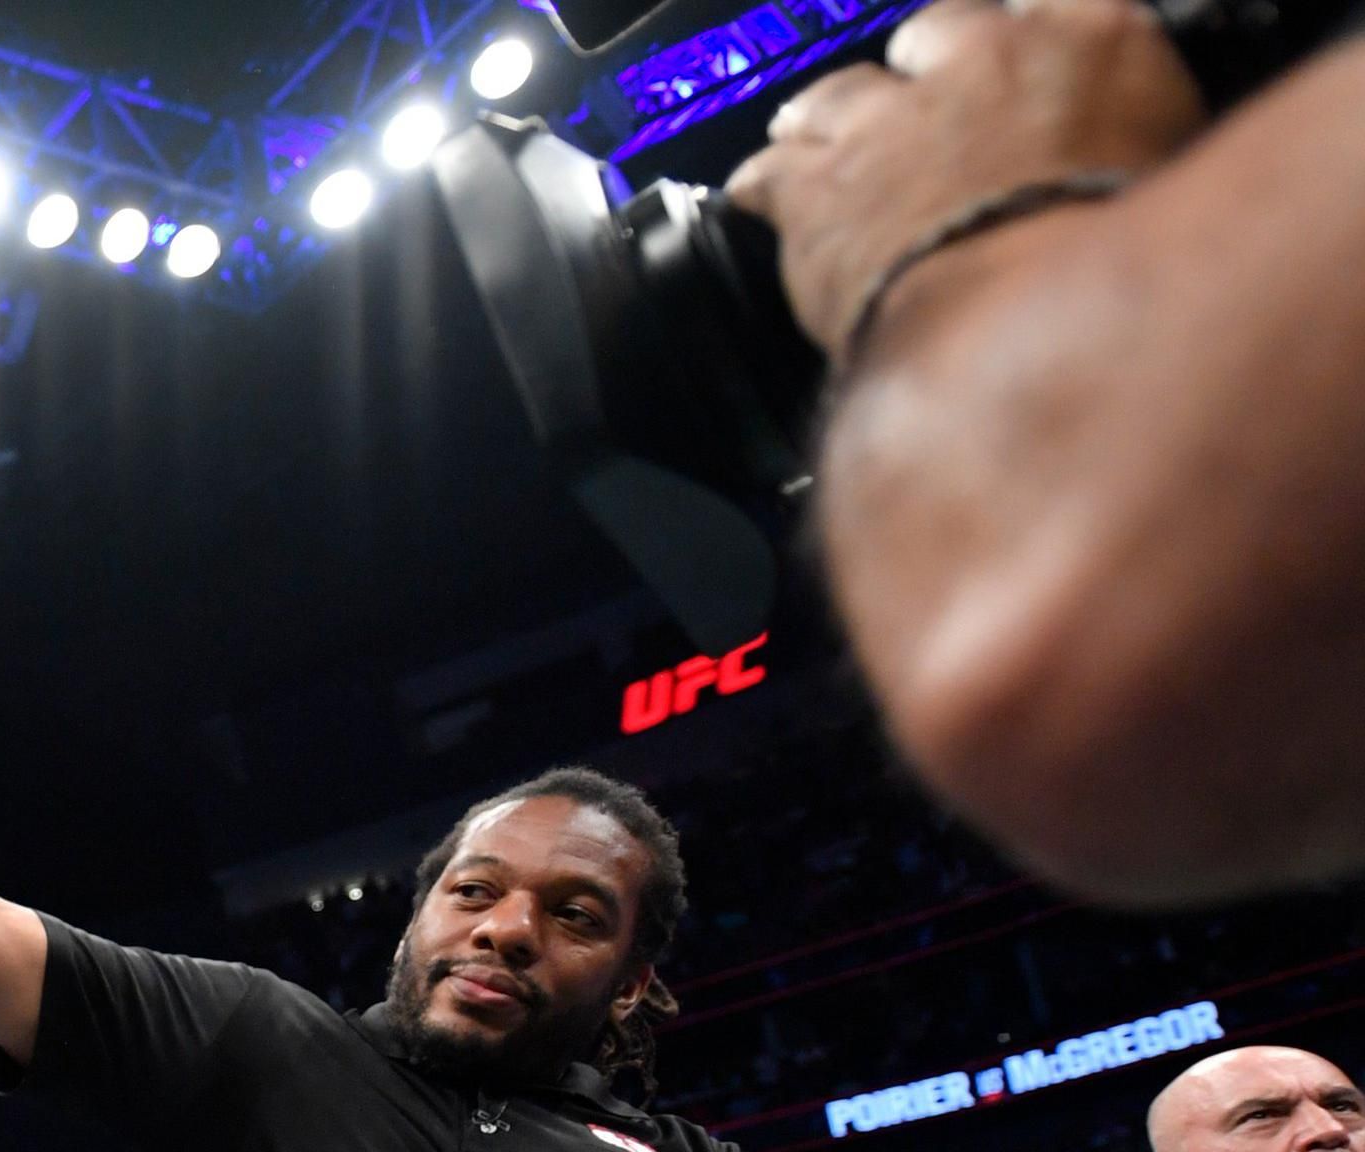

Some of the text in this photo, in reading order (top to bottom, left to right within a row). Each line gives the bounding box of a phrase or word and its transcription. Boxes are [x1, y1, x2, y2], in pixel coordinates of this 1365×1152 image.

[621, 630, 769, 735] UFC
[825, 1071, 975, 1139] POIRIER
[1004, 1001, 1225, 1096] McGREGOR
